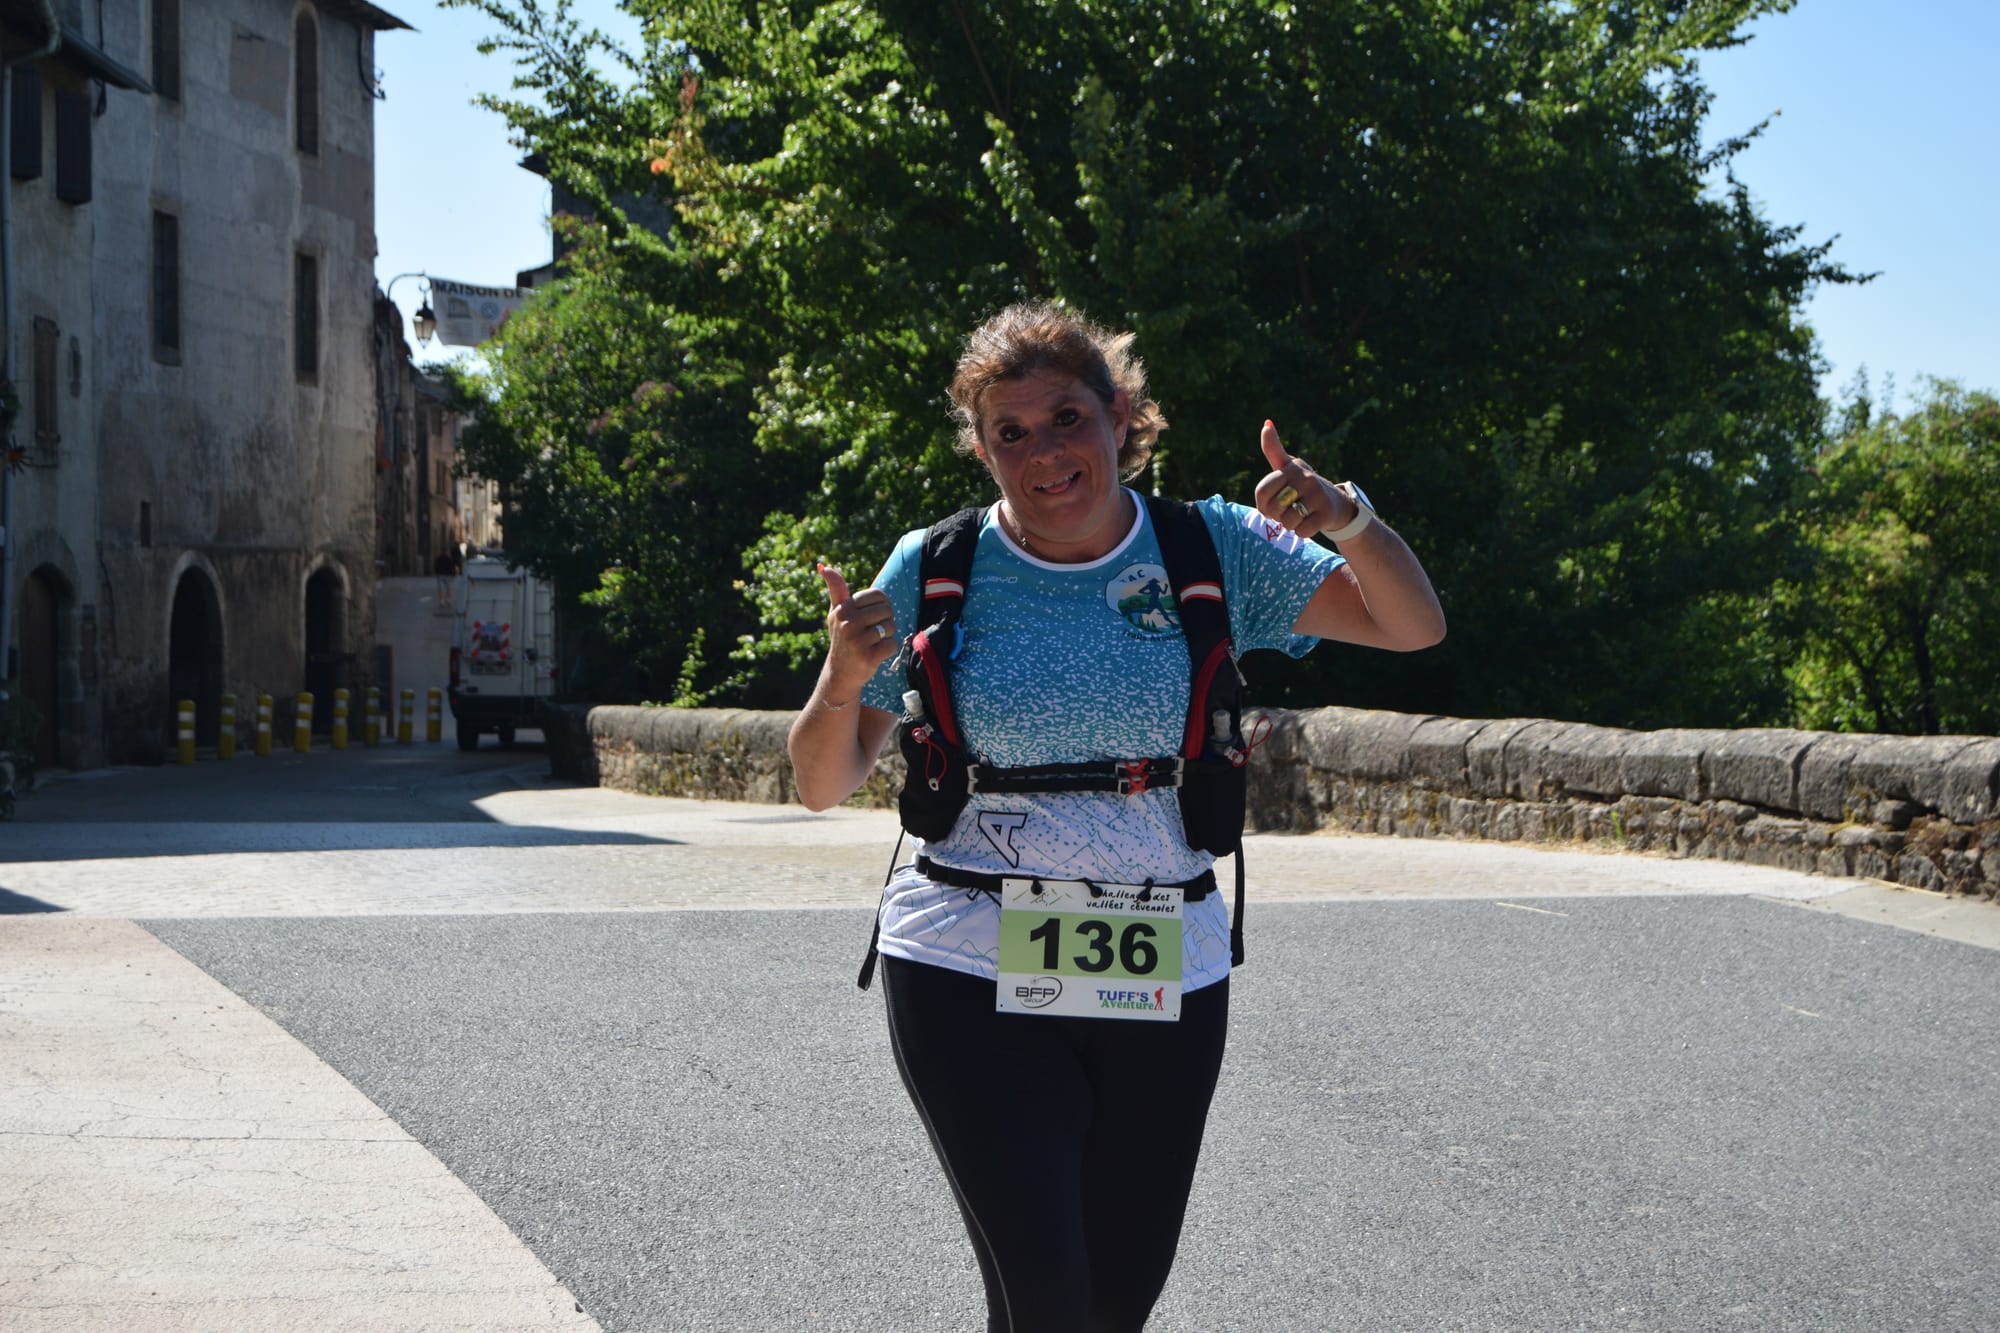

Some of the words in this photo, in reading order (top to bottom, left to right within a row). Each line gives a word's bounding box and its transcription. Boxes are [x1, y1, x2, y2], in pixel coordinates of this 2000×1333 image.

[435, 281, 498, 297] MAISON
[1098, 888, 1148, 903] halleng
[1086, 900, 1124, 910] vallées
[1029, 917, 1158, 976] 136
[1015, 986, 1055, 999] BFP
[1096, 989, 1149, 1002] TUFF'S
[1100, 998, 1154, 1011] Aventure
